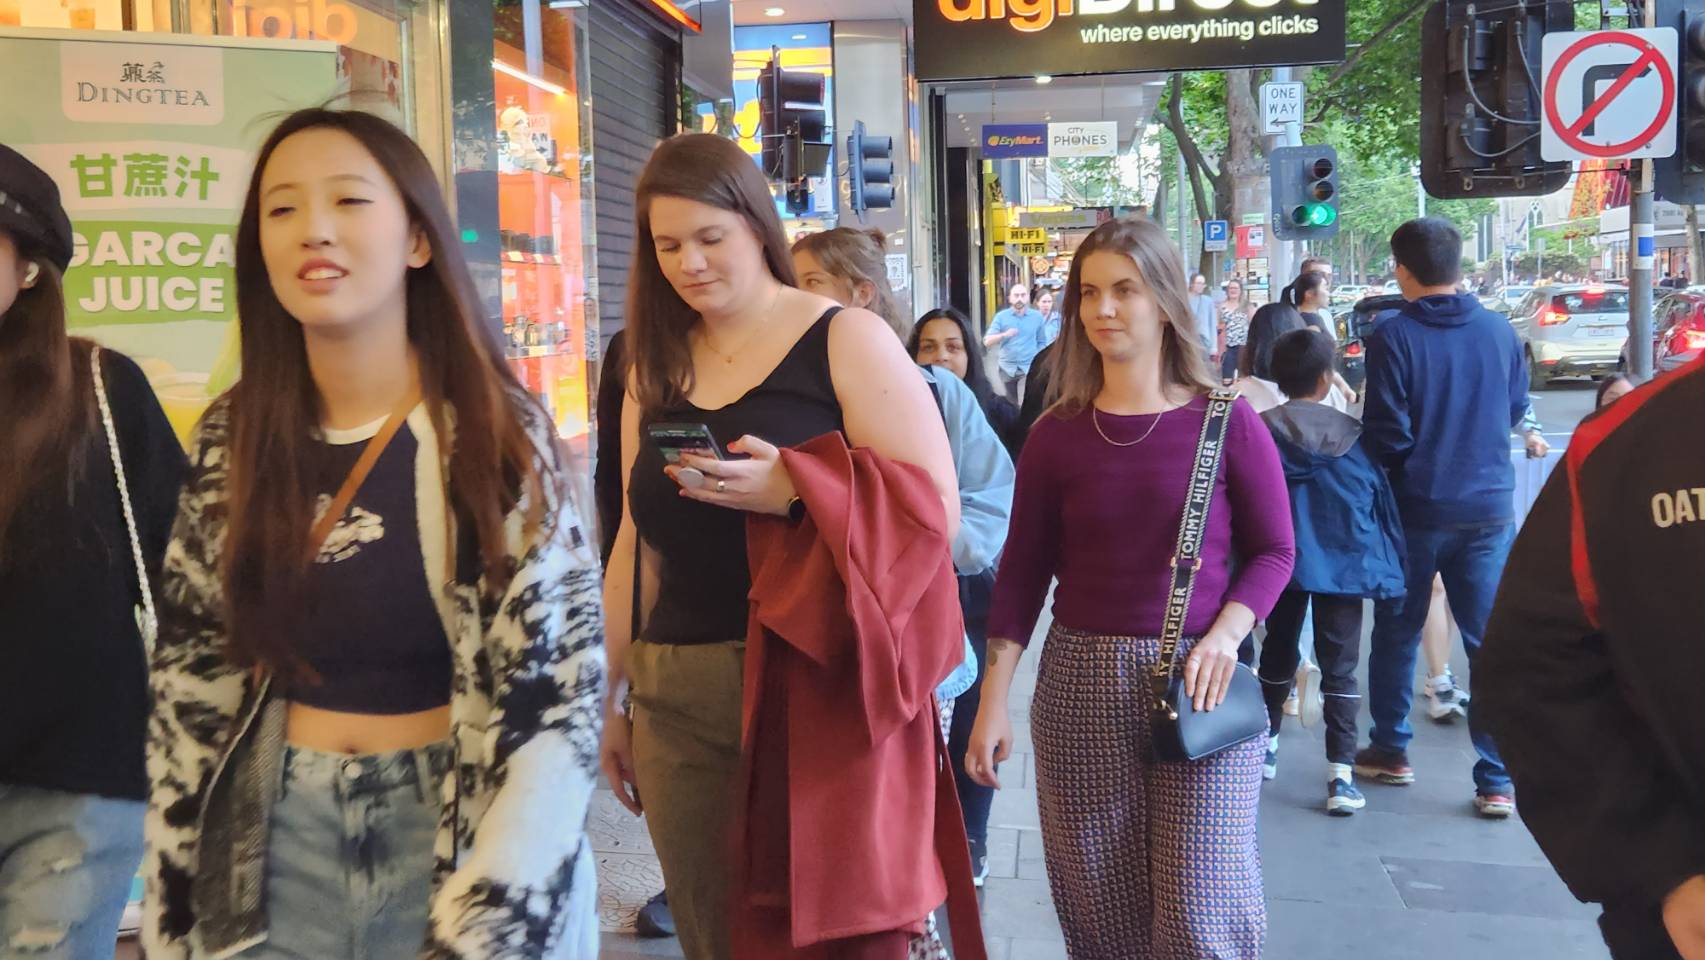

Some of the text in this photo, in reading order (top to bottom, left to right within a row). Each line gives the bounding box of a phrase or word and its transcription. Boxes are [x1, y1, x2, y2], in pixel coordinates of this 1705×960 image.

[1081, 14, 1320, 44] where everything clicks
[77, 81, 210, 107] DINGTEA
[1270, 87, 1297, 100] ONE
[1268, 103, 1298, 115] WAY
[1067, 126, 1085, 135] CITY
[1053, 134, 1108, 146] PHONES
[70, 153, 220, 201] 甘蔗汁
[1010, 230, 1040, 240] HI-FI
[1210, 224, 1222, 239] P
[1021, 244, 1046, 254] HI-FI
[78, 276, 225, 314] JUICE
[1180, 438, 1218, 561] TOMMY HILFIGER
[1162, 586, 1188, 655] HILFIGER
